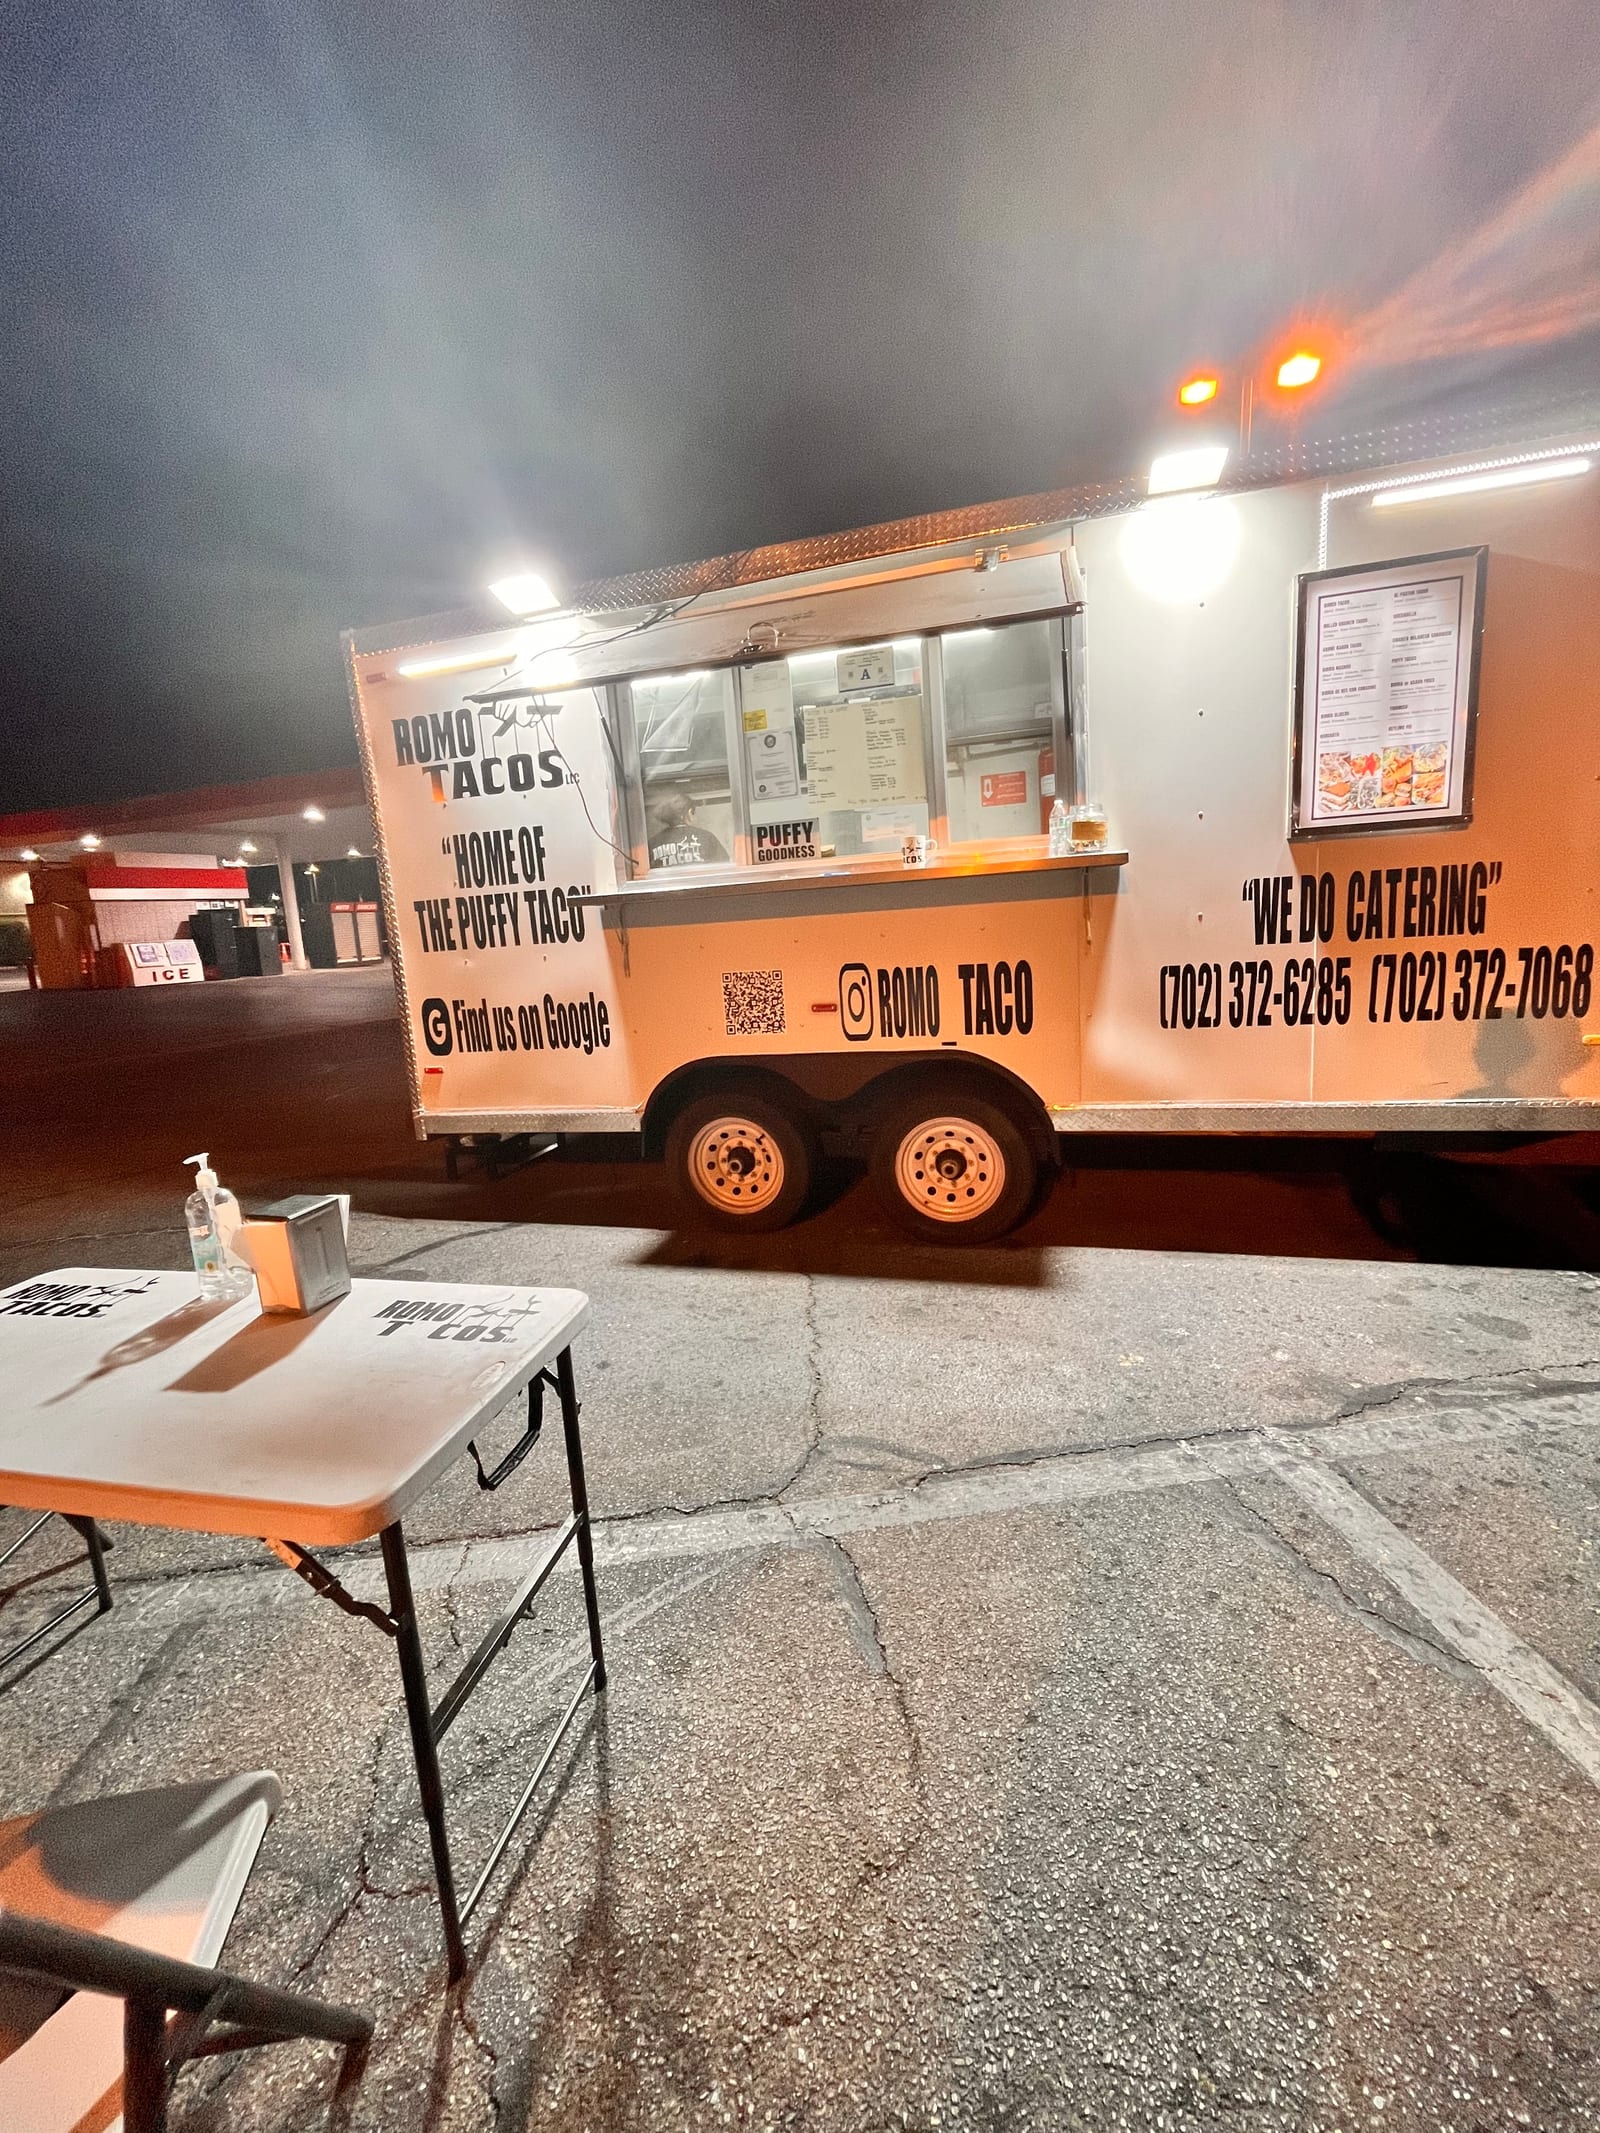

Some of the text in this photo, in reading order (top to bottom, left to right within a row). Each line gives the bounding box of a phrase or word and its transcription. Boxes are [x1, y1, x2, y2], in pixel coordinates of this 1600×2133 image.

[391, 709, 476, 767] ROMO
[422, 750, 564, 802] TACOS
[756, 821, 813, 848] PUFFY
[758, 844, 815, 862] GOODNESS
[442, 825, 546, 889] “HOME OF
[660, 852, 701, 867] TACOS
[413, 898, 457, 952] THE
[455, 891, 521, 949] PUFFY
[1242, 861, 1502, 945] “WE DO CATERING”
[152, 968, 191, 983] ICE
[1160, 943, 1594, 1030] (702) 372-6285 (702) 372-7068
[452, 998, 493, 1053] Find
[491, 1006, 517, 1051] us
[517, 1004, 544, 1051] on
[543, 991, 611, 1056] Google
[0, 1300, 113, 1318] TACOS
[3, 1283, 92, 1301] ROMO
[372, 1299, 466, 1322] ROMO
